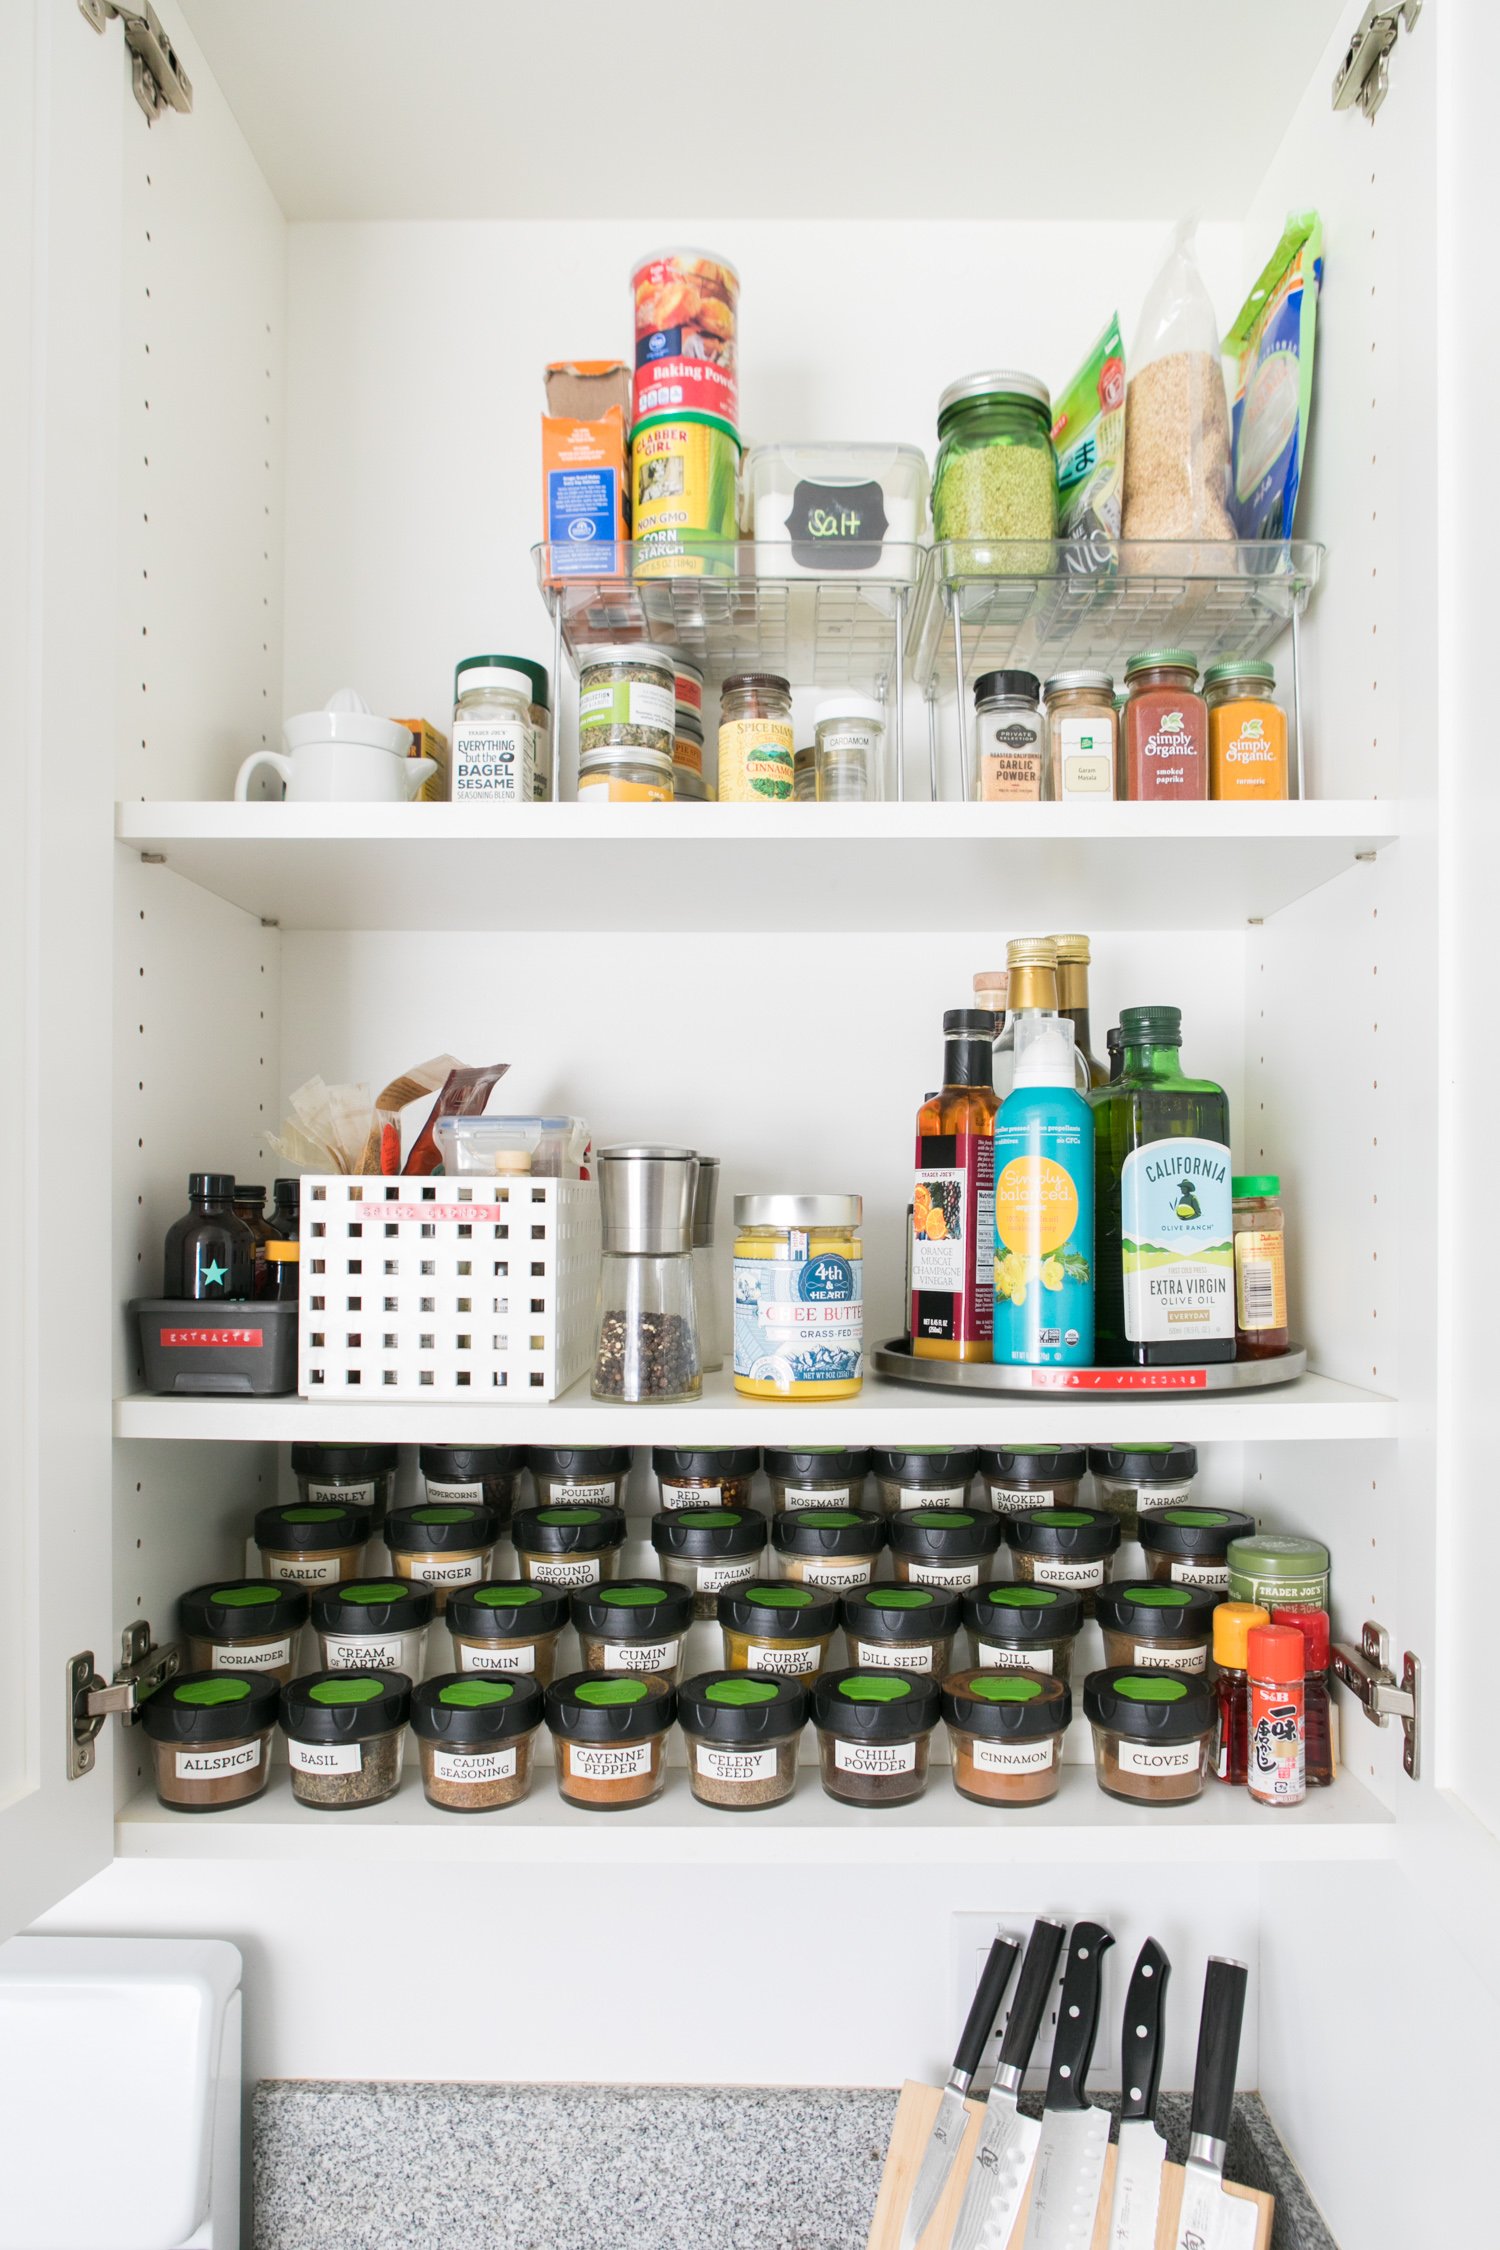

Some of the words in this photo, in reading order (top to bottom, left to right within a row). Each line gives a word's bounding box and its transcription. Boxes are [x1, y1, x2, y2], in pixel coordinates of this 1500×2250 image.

[653, 363, 702, 381] Baking
[637, 429, 688, 454] CLABBER
[645, 442, 671, 456] GIRL
[637, 513, 657, 531] NON
[659, 511, 687, 523] GMO
[808, 508, 861, 537] Salt
[643, 529, 677, 545] CORN
[638, 543, 684, 562] STARCH
[737, 723, 768, 735] SPICE
[771, 723, 794, 736] ISLAN
[458, 740, 515, 752] EVERYTHING
[829, 736, 870, 747] CARDAMOM
[465, 752, 480, 763] but
[482, 752, 497, 763] the
[458, 764, 514, 777] BAGEL
[746, 760, 794, 776] CINNAMO
[999, 760, 1033, 770] GARLIC
[1156, 767, 1184, 775] smoked
[996, 770, 1036, 781] POWDER
[1156, 775, 1184, 784] paprika
[457, 778, 515, 789] SESAME
[457, 791, 493, 800] SEASONING
[494, 791, 515, 799] BLEND
[1145, 1156, 1227, 1184] CALIFORNIA
[1004, 1167, 1067, 1192] Simply
[1185, 1224, 1212, 1232] RANCH
[920, 1246, 953, 1257] ORANGE
[920, 1256, 952, 1266] MUSCAT
[814, 1262, 843, 1281] 4th
[912, 1265, 961, 1276] CHAMPAGNE
[825, 1281, 833, 1290] &
[919, 1275, 953, 1285] VINEGAR
[1150, 1279, 1183, 1296] EXTRA
[1185, 1278, 1226, 1294] VIRGIN
[809, 1289, 846, 1299] HEART
[1161, 1297, 1193, 1306] OLIVE
[1198, 1296, 1216, 1305] OIL
[766, 1306, 817, 1321] GEE
[824, 1305, 863, 1321] BUTTE
[1169, 1312, 1209, 1320] EVERYDAY
[169, 1331, 251, 1343] EXTRACTS
[800, 1329, 852, 1338] GRASS-FED
[803, 1371, 815, 1380] NET
[816, 1371, 825, 1379] WT
[1115, 1376, 1197, 1385] VINEGARS
[315, 1490, 367, 1502] PARSLEY
[561, 1487, 606, 1498] POULTRY
[676, 1490, 700, 1501] RED
[996, 1492, 1046, 1504] SMOKED
[554, 1495, 610, 1506] SEASONING
[670, 1498, 712, 1510] PEPPER
[790, 1496, 846, 1509] ROSEMARY
[920, 1497, 951, 1509] SAGE
[1143, 1494, 1190, 1506] TARRAGON
[279, 1567, 327, 1579] GARLIC
[422, 1567, 472, 1580] GINGER
[537, 1564, 591, 1577] GROUND
[714, 1566, 752, 1580] ITALIAN
[1040, 1568, 1100, 1581] OREGANO
[534, 1572, 595, 1585] OREGANO
[808, 1572, 868, 1586] MUSTARD
[916, 1574, 972, 1587] NUTMEG
[1181, 1573, 1229, 1585] PAPRIK
[1259, 1586, 1298, 1597] TRADER
[1299, 1586, 1321, 1596] JOE'S
[219, 1650, 284, 1665] CORIANDER
[337, 1647, 386, 1659] CREAM
[618, 1648, 667, 1661] CUMIN
[762, 1651, 809, 1664] CURRY
[862, 1651, 891, 1667] DILL
[893, 1655, 928, 1667] SEED
[999, 1652, 1030, 1665] DILL
[343, 1656, 396, 1669] TARTAR
[472, 1656, 519, 1669] CUMIN
[625, 1659, 661, 1671] SEED
[756, 1661, 814, 1674] POWDER
[1141, 1654, 1205, 1668] FIVE-SPICE
[1259, 1689, 1289, 1702] S&B
[184, 1750, 254, 1770] ALLSPICE
[300, 1752, 338, 1767] BASIL
[576, 1748, 645, 1763] CAYENNE
[708, 1753, 763, 1767] CELERY
[855, 1748, 896, 1761] CHILI
[980, 1751, 1048, 1765] CINNAMON
[1132, 1754, 1189, 1767] CLOVES
[452, 1757, 496, 1768] CAJUN
[584, 1761, 638, 1775] PEPPER
[844, 1757, 907, 1772] POWDER
[440, 1765, 510, 1778] SEASONING
[716, 1766, 754, 1778] SEED
